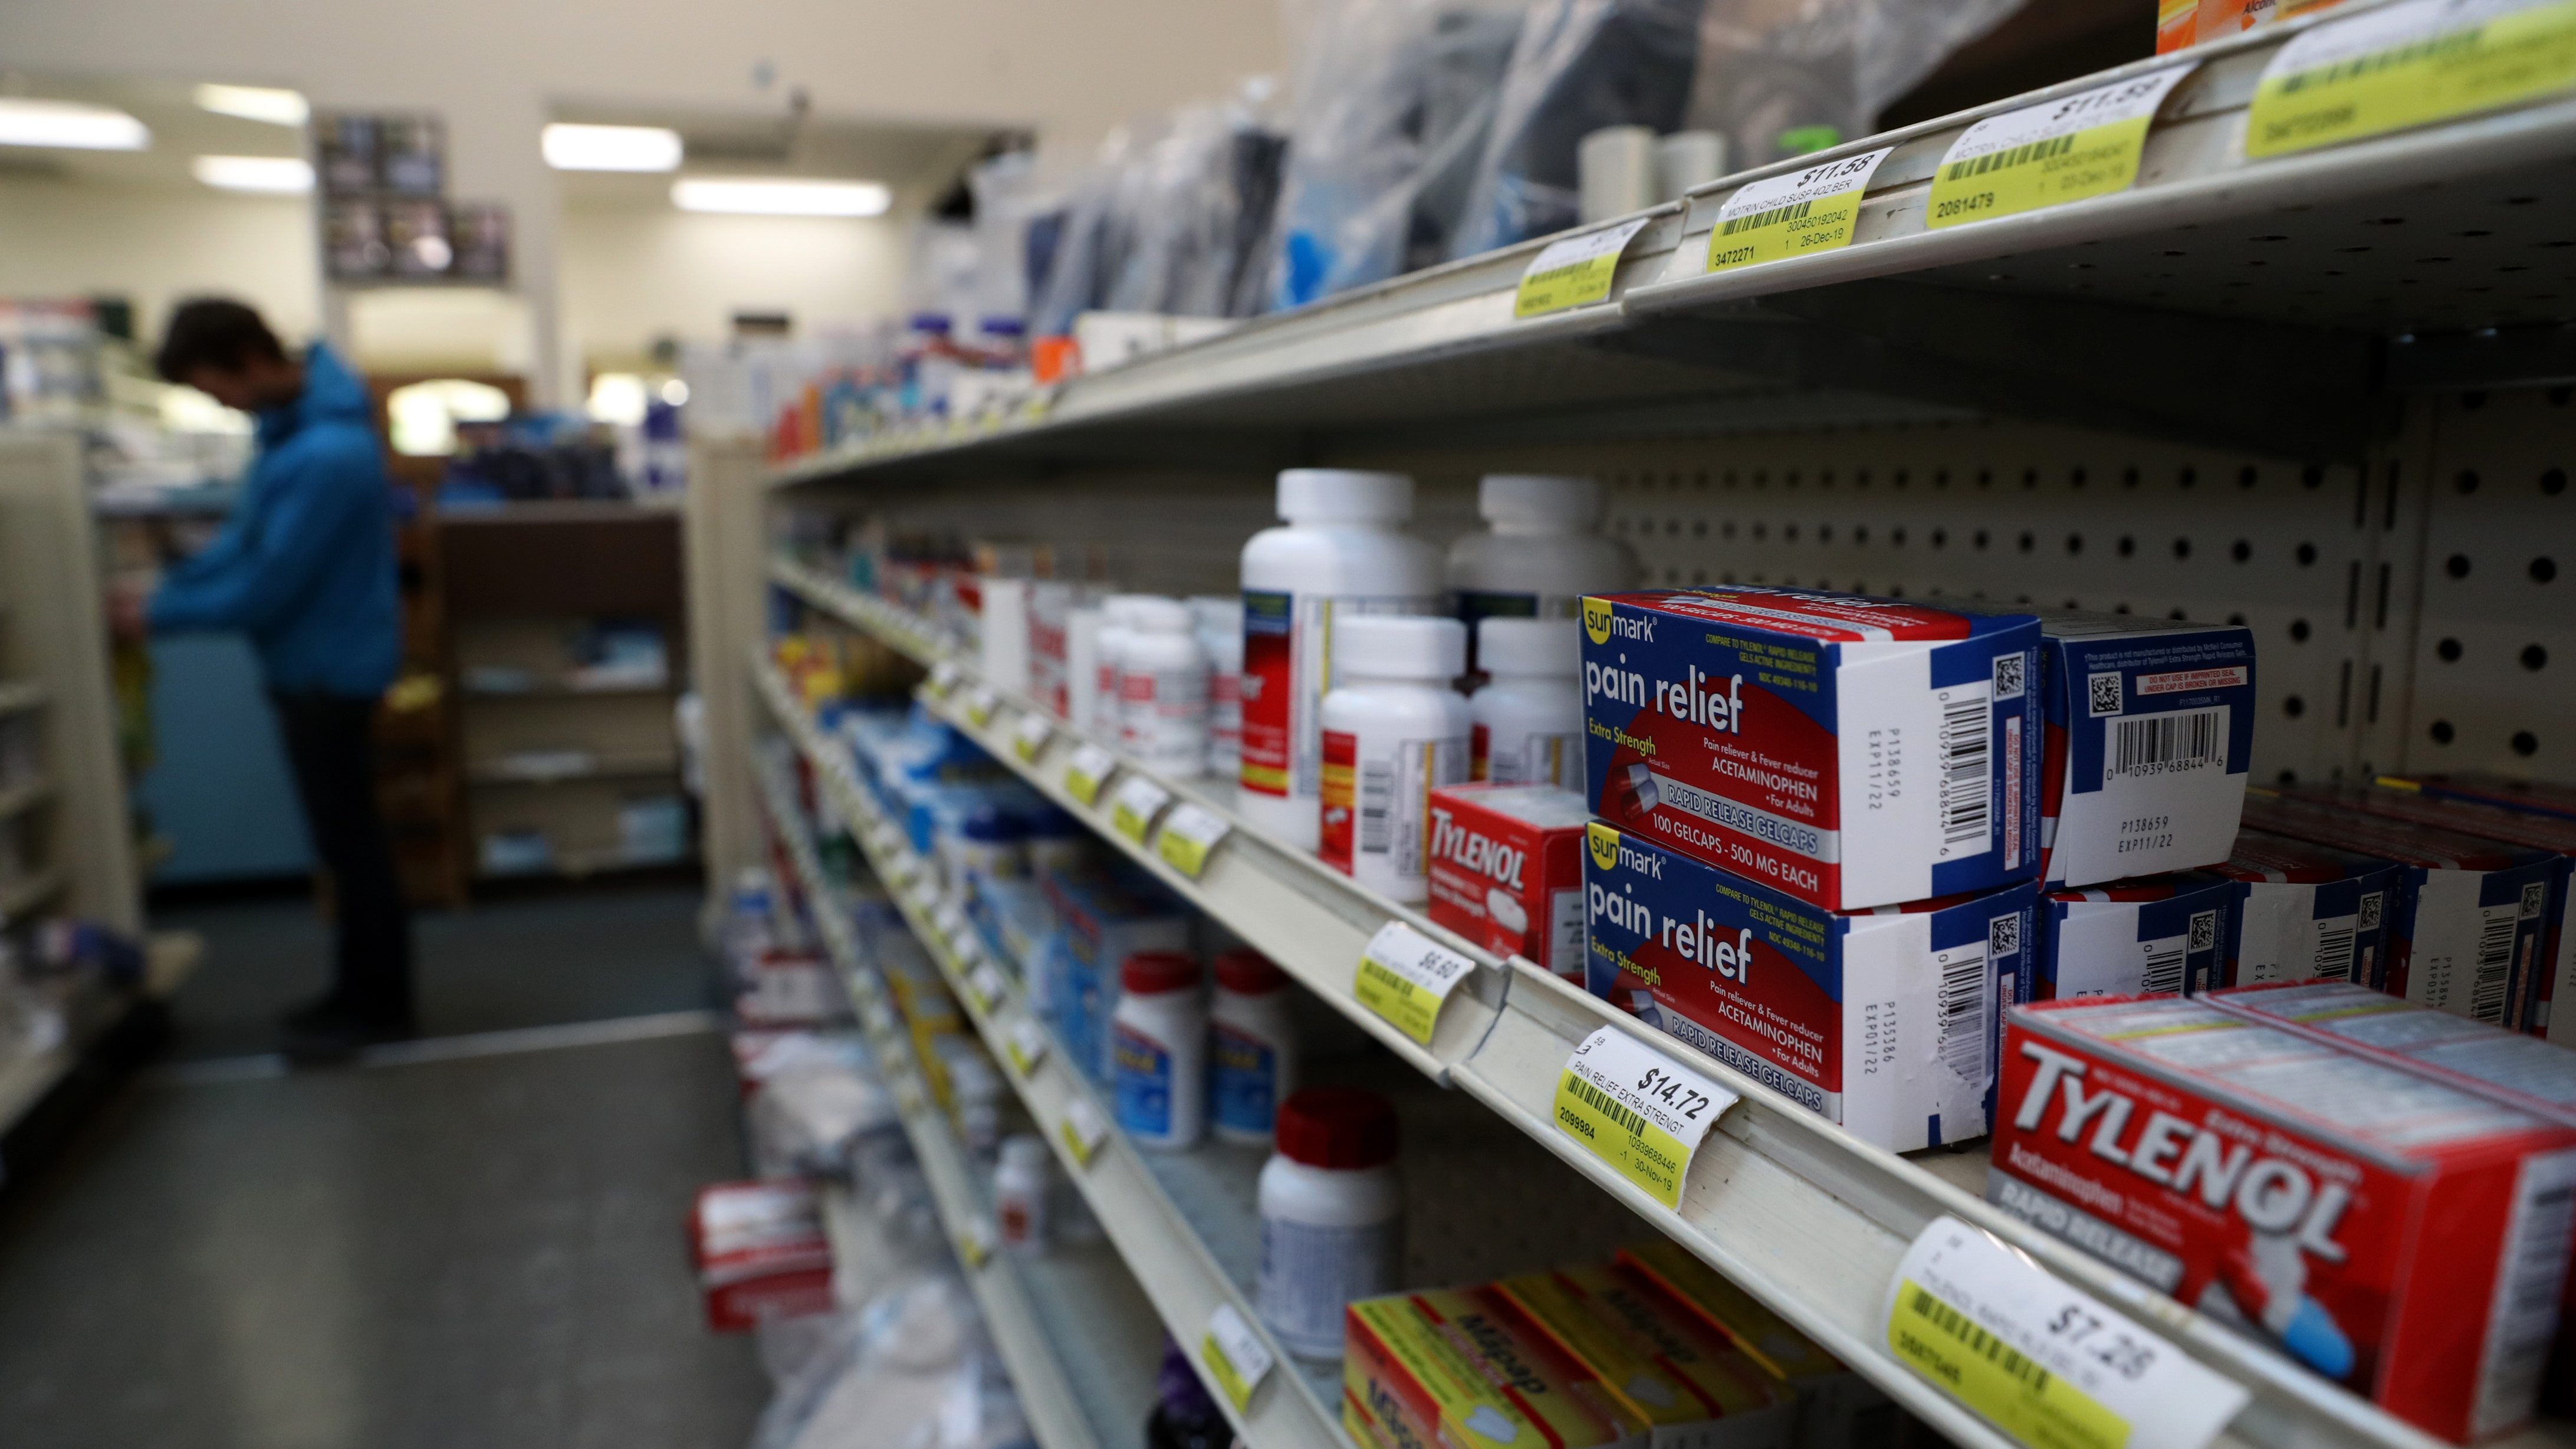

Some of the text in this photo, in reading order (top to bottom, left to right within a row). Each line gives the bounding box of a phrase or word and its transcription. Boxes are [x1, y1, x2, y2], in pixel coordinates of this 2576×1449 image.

[1798, 154, 1875, 188] $11.58
[1727, 202, 1759, 218] MOTRIN
[1760, 195, 1787, 210] CHILD
[1787, 189, 1812, 203] SUSP
[1831, 179, 1852, 193] BER
[1787, 209, 1848, 233] 300450192042
[1937, 192, 1995, 218] 2081479
[1715, 246, 1754, 267] 3472271
[1800, 228, 1844, 248] 26-Dec-19
[1706, 633, 1731, 647] COMPARE
[1739, 652, 1754, 663] GELS
[1586, 653, 1743, 734] pain relief
[2145, 685, 2164, 694] UNDER
[2166, 684, 2178, 692] CAP
[2185, 680, 2207, 689] BROKEN
[2218, 676, 2240, 686] MISSING
[2159, 675, 2171, 683] NOT
[2172, 673, 2183, 682] USE
[2222, 668, 2235, 677] SEAL
[1589, 718, 1656, 757] Extra Strength
[1704, 737, 1819, 780] Pain reliever & Fever reducer
[1712, 757, 1818, 802] ACETAMINOPHEN
[1869, 730, 1882, 810] EXP11/22
[1888, 728, 1900, 797] P138659
[1939, 692, 1950, 856] 0 10939 68844 6
[2107, 757, 2223, 780] 0 10939 68844 6
[1668, 784, 1818, 855] RAPID RELEASE GELCAPS
[1786, 799, 1815, 818] Adults
[2121, 816, 2168, 833] P138659
[1431, 807, 1525, 892] TYLENOL
[1652, 813, 1818, 892] 100 GELCAPS 500 MG EACH
[2118, 834, 2173, 853] EXP11/22
[1716, 883, 1741, 901] COMPARE
[1743, 894, 1750, 904] TO
[1780, 908, 1797, 923] RAPID
[1798, 916, 1825, 935] RELEASE
[1750, 908, 1764, 922] GELS
[1765, 915, 1785, 930] ACTIVE
[1589, 883, 1751, 984] pain relief
[1769, 931, 1782, 944] NDC
[2476, 937, 2487, 972] 10939
[1592, 937, 1661, 987] Extra Strength
[1938, 954, 1949, 962] 0
[1937, 982, 1949, 1027] 10939
[2425, 958, 2439, 1007] EXP03/2
[2437, 957, 2452, 1007] P135894
[1710, 981, 1824, 1042] Pain reliever & Fever reducer
[1719, 1001, 1823, 1063] ACETAMINOPHEN
[1884, 1001, 1896, 1063] P135386
[1864, 1004, 1878, 1075] EXP01/22
[1673, 1016, 1822, 1112] RAPID RELEASE GELCAPS
[1792, 1056, 1820, 1078] Adults
[1574, 1061, 1684, 1136] PAIN RELIEF EXTRA STRENGT
[1638, 1067, 1709, 1120] $14.72
[1560, 1107, 1595, 1140] 2099984
[1620, 1151, 1672, 1191] -1 30-Nov-19
[1628, 1135, 1676, 1174] 10939688446
[2015, 1040, 2347, 1263] TYLENOL
[2009, 1141, 2123, 1215] Acetaminophen
[2001, 1182, 2064, 1233] RAPID
[2068, 1215, 2184, 1294] RELEASE
[1458, 1313, 1547, 1396] Mapap
